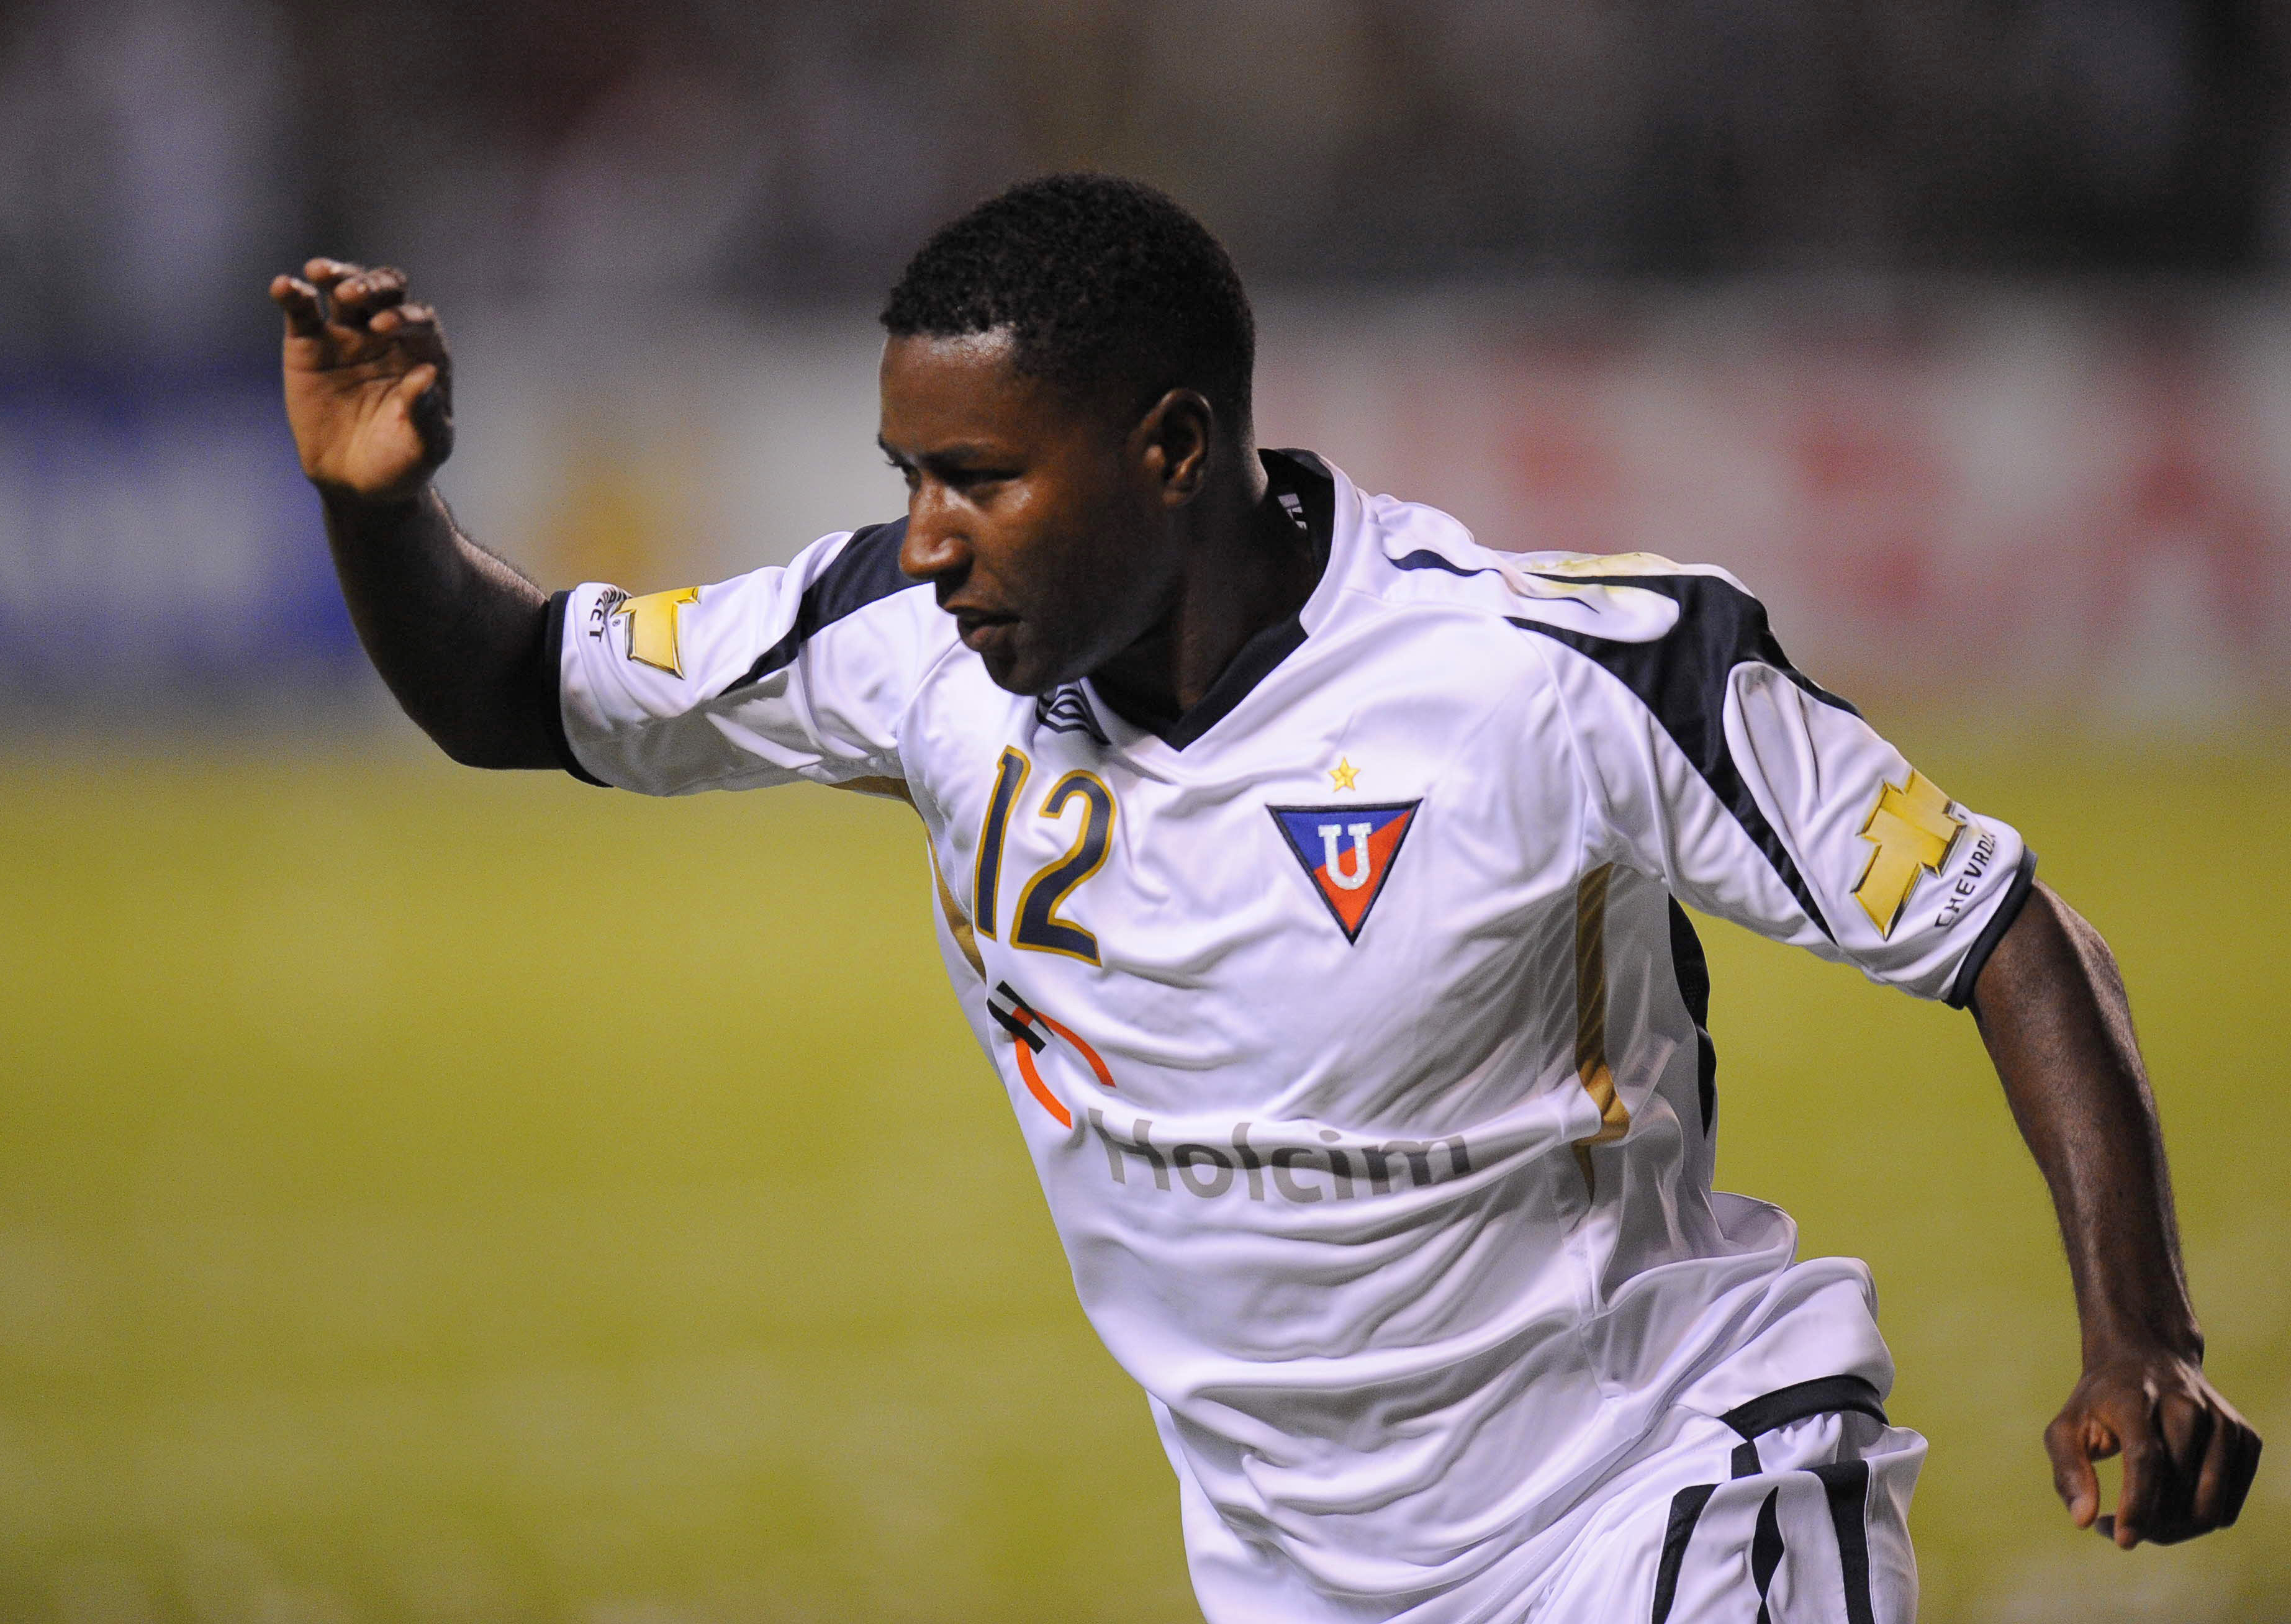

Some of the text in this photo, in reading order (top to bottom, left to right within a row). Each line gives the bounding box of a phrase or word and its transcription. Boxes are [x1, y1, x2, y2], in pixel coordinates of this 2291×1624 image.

[974, 744, 1117, 968] 12
[1317, 821, 1372, 890] U
[1088, 1108, 1471, 1203] Holcim
